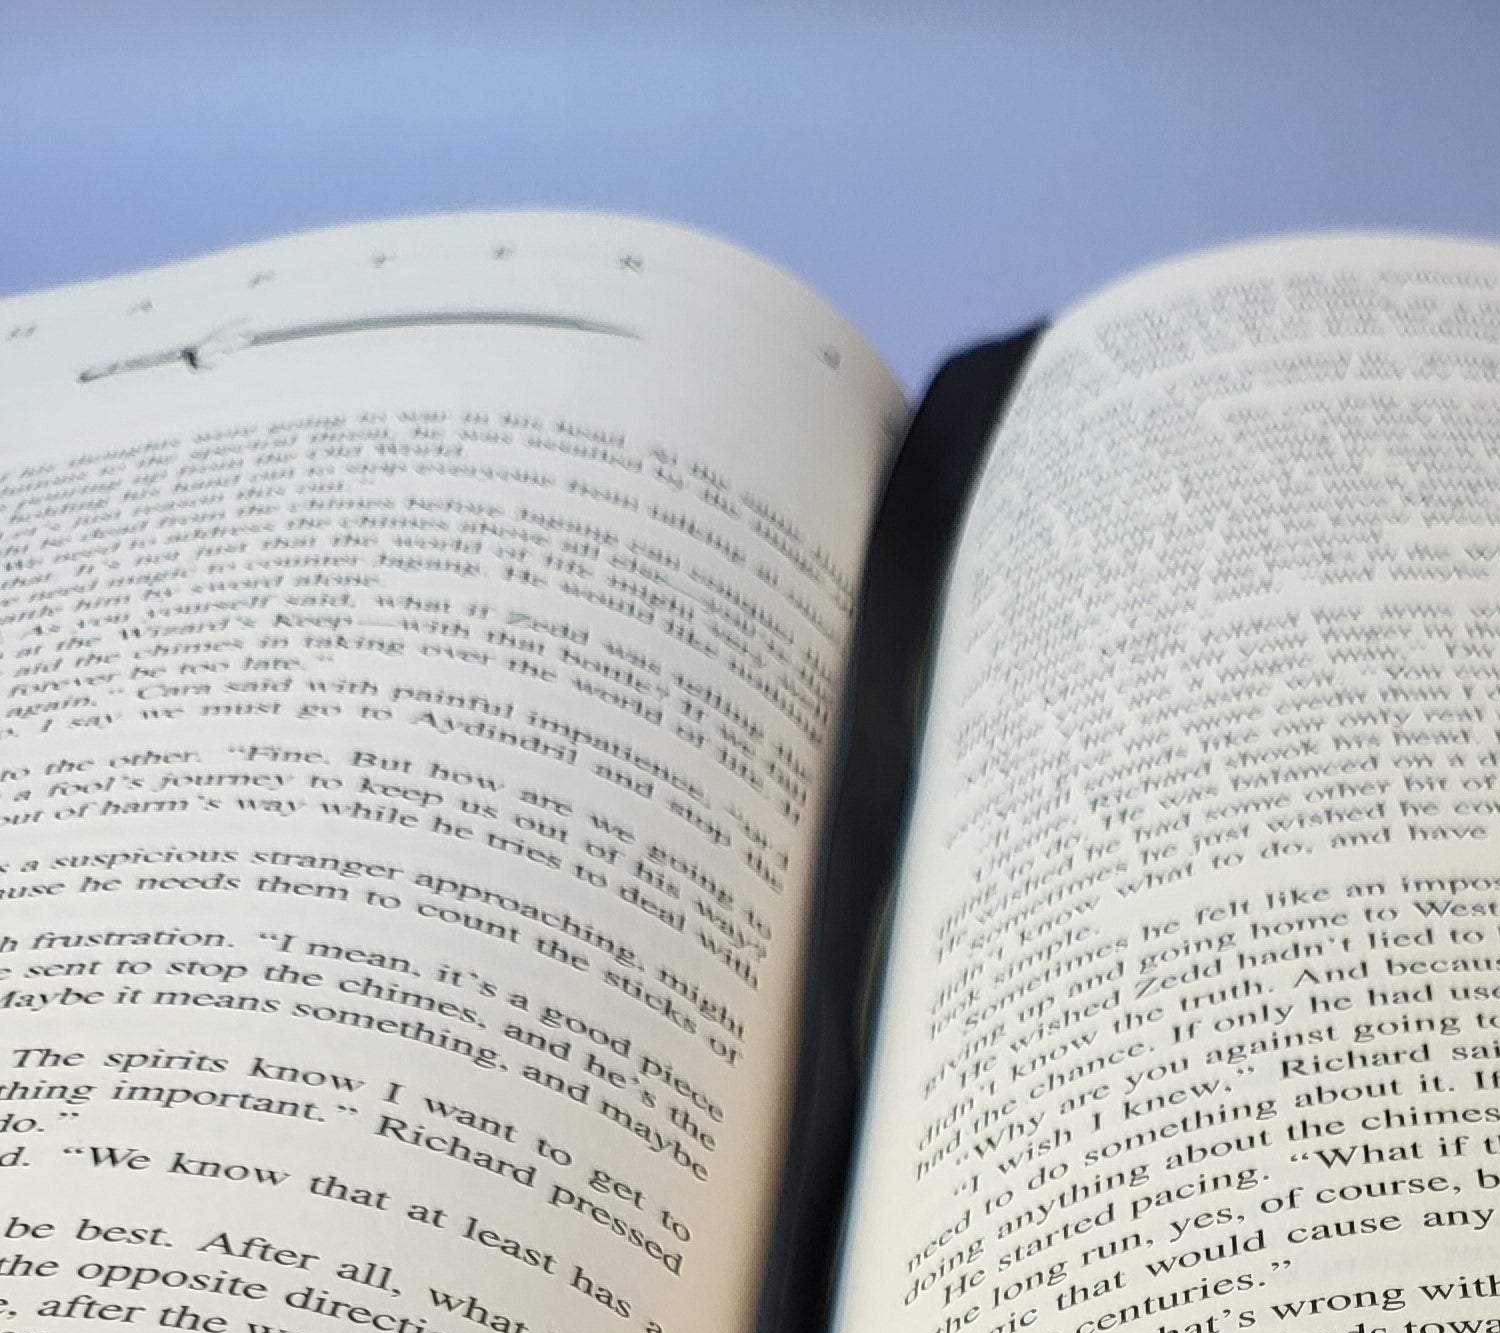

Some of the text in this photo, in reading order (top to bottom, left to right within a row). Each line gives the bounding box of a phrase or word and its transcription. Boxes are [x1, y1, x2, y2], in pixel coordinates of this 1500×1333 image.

[352, 750, 412, 774] But
[430, 763, 504, 792] how
[22, 959, 102, 980] sent
[114, 958, 154, 976] to
[164, 959, 249, 984] stop
[262, 962, 324, 988] the
[502, 1022, 573, 1062] and
[668, 1105, 716, 1153] the
[30, 926, 236, 951] frustration.
[506, 992, 530, 1013] a
[538, 1005, 632, 1060] good
[638, 1054, 724, 1124] piece
[114, 984, 144, 1006] it
[151, 990, 282, 1014] means
[520, 1063, 592, 1106] and
[598, 1099, 709, 1183] maybe
[12, 1046, 692, 1243] The spirits know I want to get to
[110, 1078, 360, 1124] important.”
[372, 1113, 538, 1189] Richard
[546, 1183, 684, 1278] pressed
[902, 1237, 985, 1308] doing
[996, 1163, 1151, 1241] anything
[1164, 1128, 1269, 1171] about
[1286, 1118, 1346, 1142] the
[942, 1268, 986, 1308] He
[996, 1200, 1116, 1274] started
[1130, 1167, 1270, 1221] pacing.
[1288, 1140, 1423, 1170] “What
[1438, 1134, 1470, 1158] if
[2, 1215, 56, 1240] be
[74, 1216, 174, 1249] best.
[194, 1230, 322, 1272] After
[334, 1260, 402, 1299] all,
[35, 1293, 148, 1324] after
[62, 1144, 152, 1171] “We
[166, 1150, 292, 1187] know
[308, 1174, 392, 1212] that
[406, 1203, 449, 1230] at
[460, 1215, 558, 1276] least
[568, 1264, 632, 1320] has
[76, 1261, 268, 1301] opposite
[992, 1259, 1068, 1309] long
[1080, 1231, 1154, 1267] run,
[1168, 1206, 1246, 1244] yes,
[1258, 1185, 1304, 1215] of
[1314, 1175, 1462, 1205] course,
[1055, 1269, 1124, 1312] that
[1144, 1227, 1267, 1278] would
[1286, 1214, 1403, 1245] cause
[1422, 1207, 1496, 1232] any
[1268, 1286, 1407, 1321] wrong
